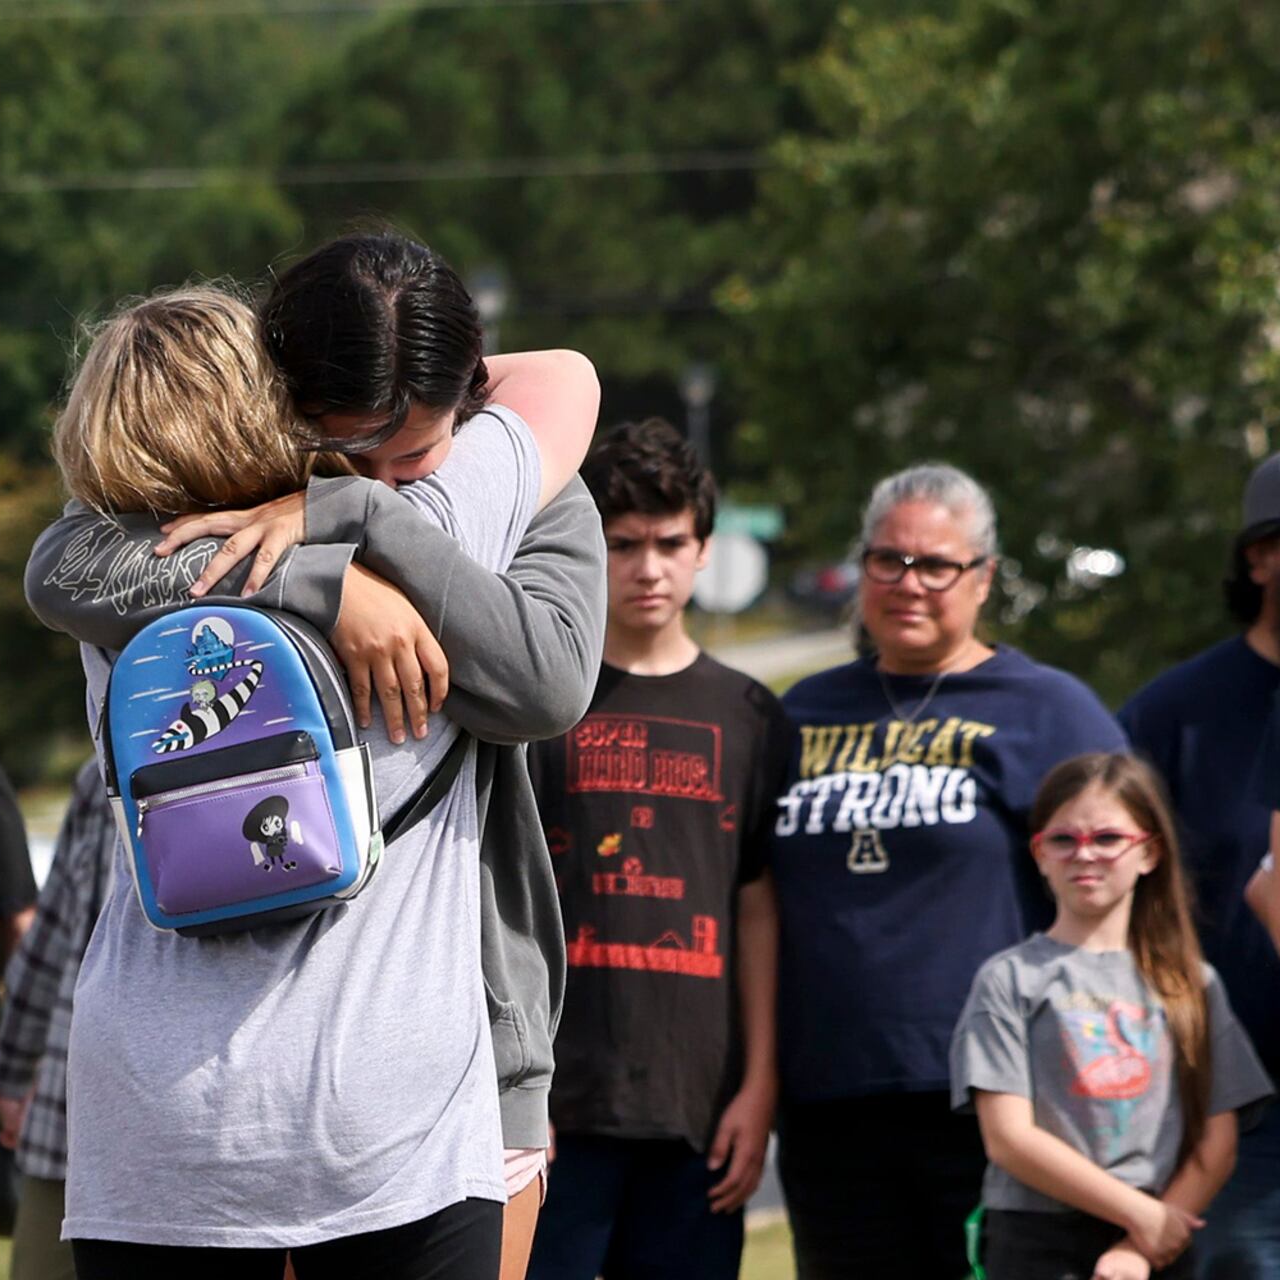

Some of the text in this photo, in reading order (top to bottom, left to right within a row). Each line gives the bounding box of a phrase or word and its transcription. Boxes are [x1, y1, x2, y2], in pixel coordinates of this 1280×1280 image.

[575, 722, 649, 748] SUPER
[800, 717, 996, 778] WILDCAT
[577, 749, 647, 790] MARIO
[775, 763, 977, 836] STRONG
[847, 828, 890, 875] A
